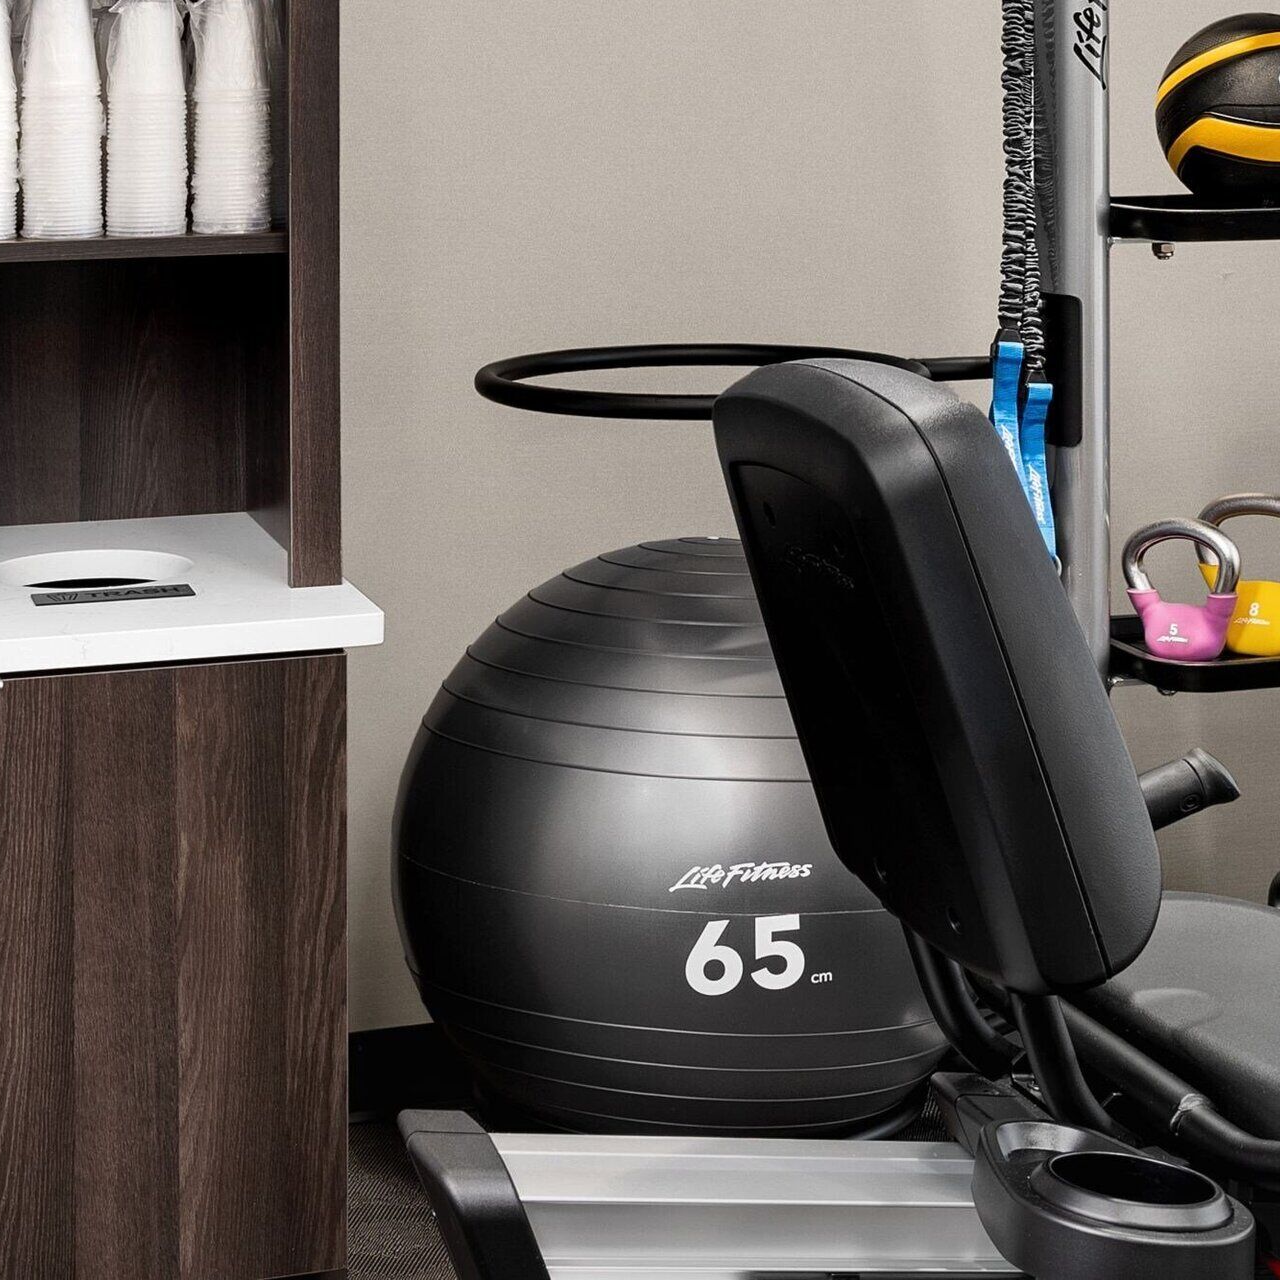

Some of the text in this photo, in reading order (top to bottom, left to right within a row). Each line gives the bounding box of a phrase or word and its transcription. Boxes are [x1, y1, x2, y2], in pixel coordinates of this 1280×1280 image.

[83, 586, 180, 598] TRASH
[1249, 602, 1260, 616] 8
[1169, 623, 1178, 635] 5
[685, 914, 833, 996] 65 cm
